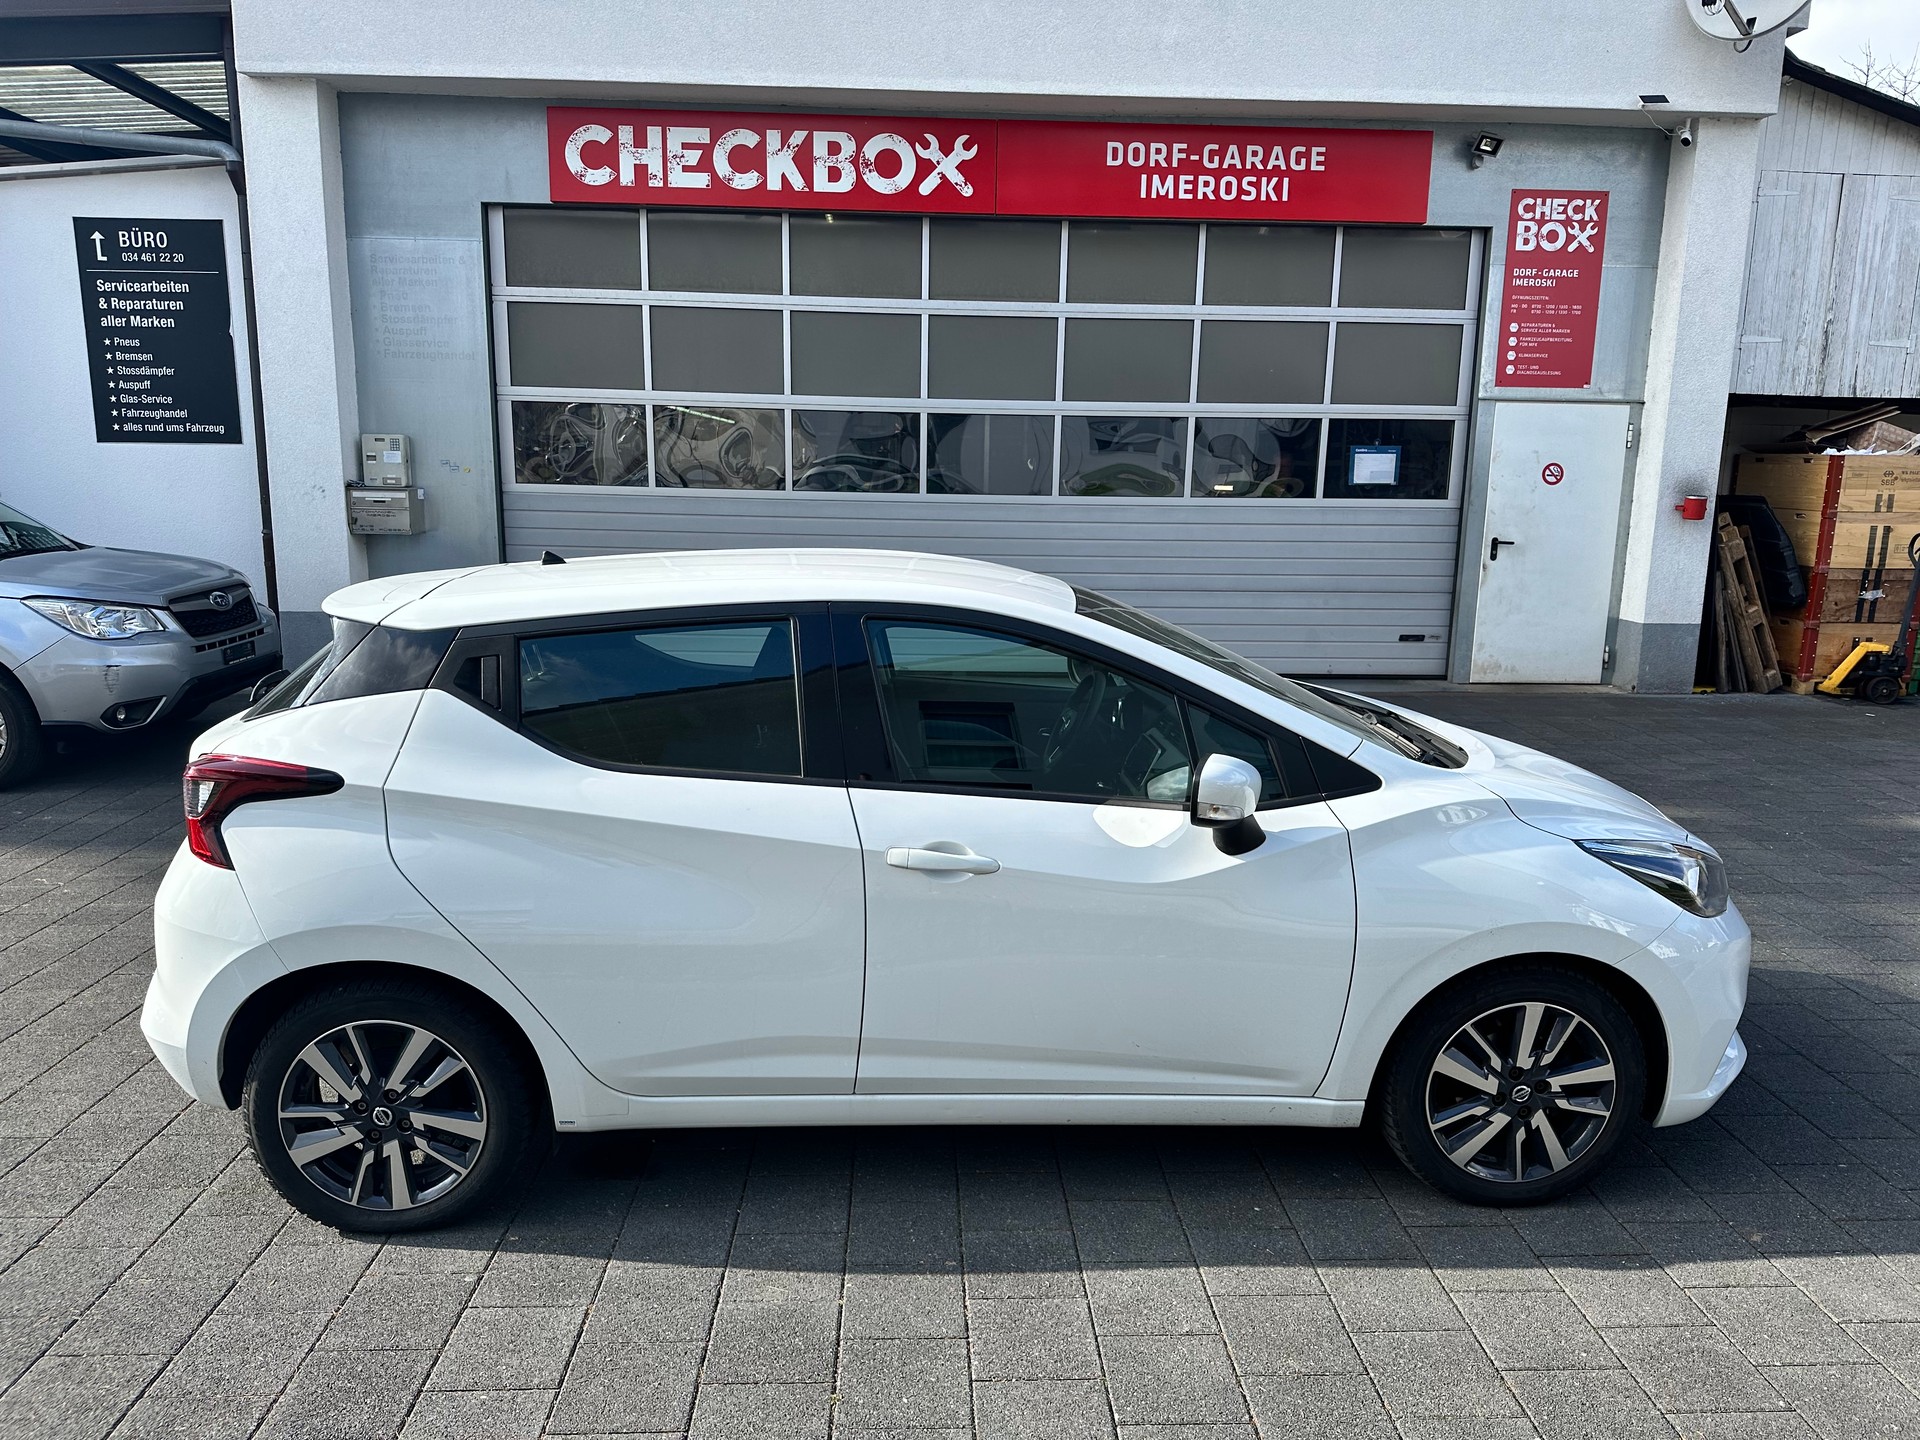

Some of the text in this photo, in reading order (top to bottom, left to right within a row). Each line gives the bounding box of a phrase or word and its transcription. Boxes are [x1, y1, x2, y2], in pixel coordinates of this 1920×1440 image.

[1106, 141, 1327, 171] DORF-GARAGE
[1140, 174, 1289, 202] IMEROSKI
[1517, 197, 1601, 221] CHECK
[118, 227, 168, 248] BÜRO
[121, 252, 184, 263] 034 461 22 20
[96, 279, 190, 293] Servicearbeiten
[1512, 278, 1556, 287] IMEROSKI
[98, 297, 184, 312] & Reparaturen
[100, 315, 175, 328] aller Marken
[114, 337, 140, 347] Pneus
[115, 352, 153, 361] Bremsen
[117, 365, 175, 378] Stossdämpfer
[118, 380, 151, 391] Auspuff
[120, 394, 173, 404] Glas-Service
[121, 408, 188, 420] Fahrzeughandel
[123, 423, 143, 432] alles
[144, 423, 164, 432] rund
[186, 423, 225, 435] Fahrzeug
